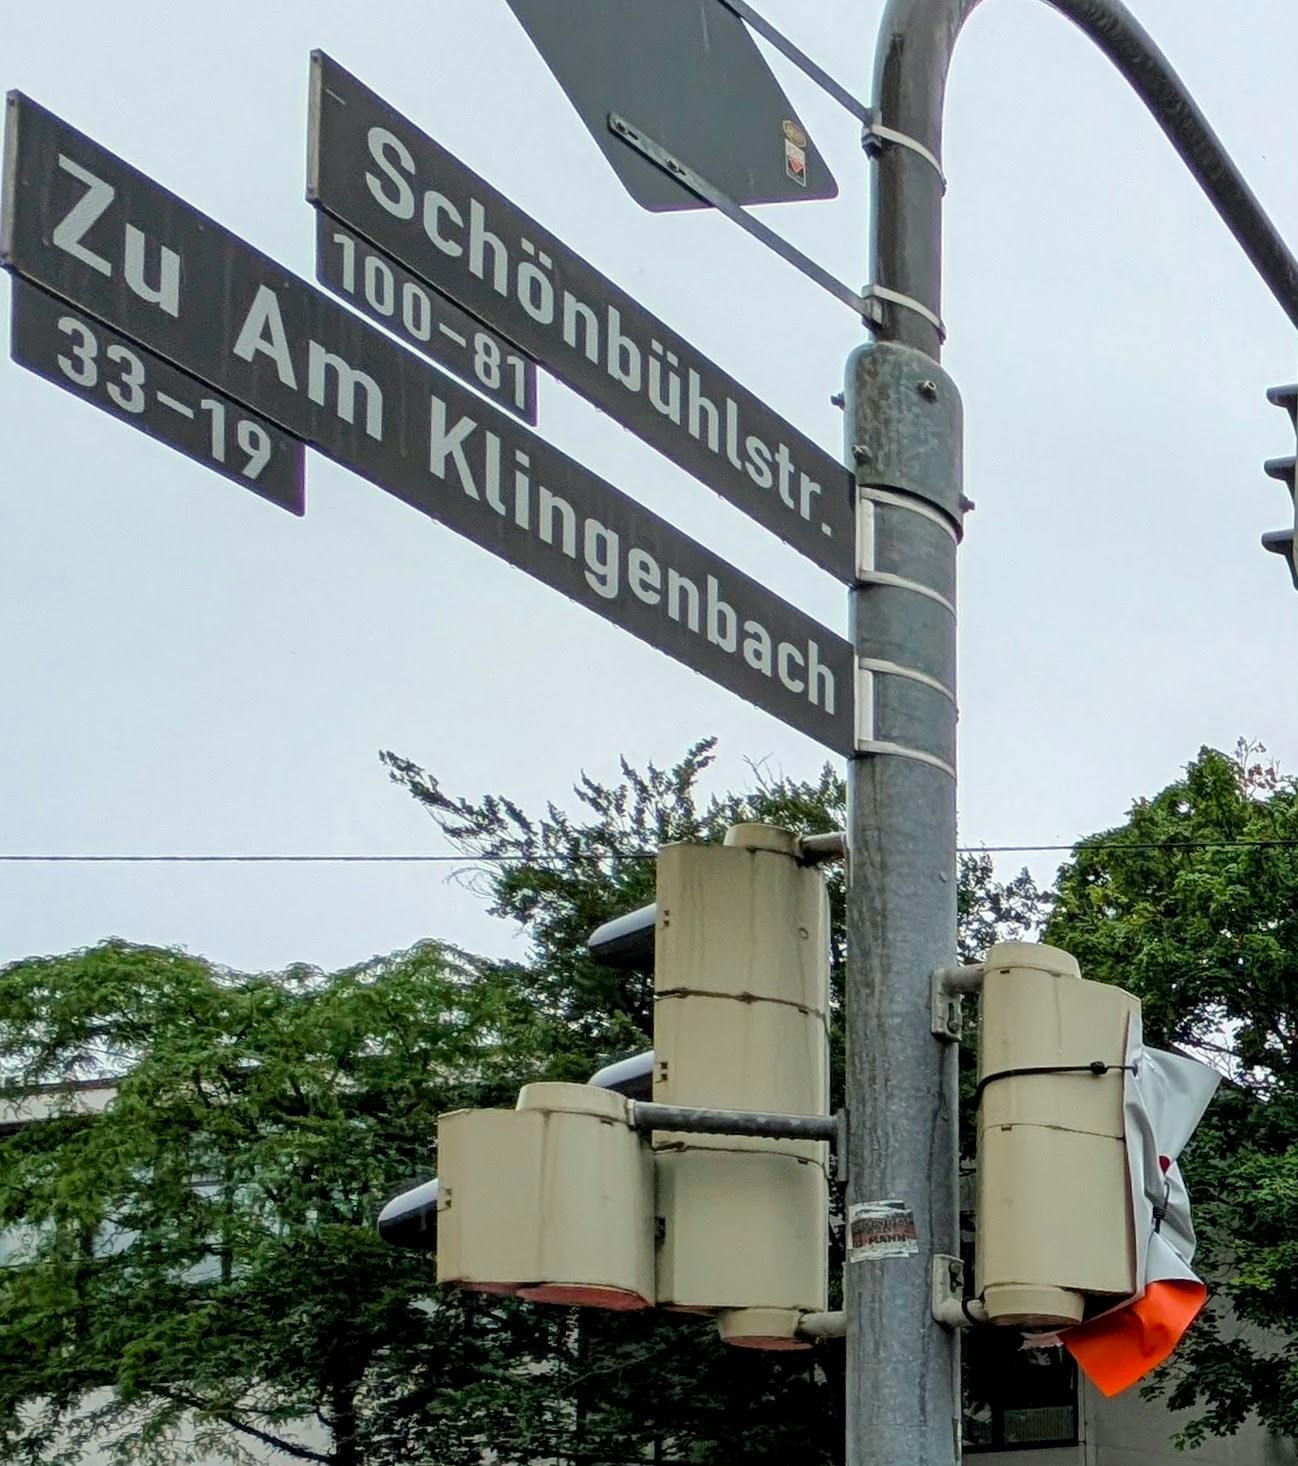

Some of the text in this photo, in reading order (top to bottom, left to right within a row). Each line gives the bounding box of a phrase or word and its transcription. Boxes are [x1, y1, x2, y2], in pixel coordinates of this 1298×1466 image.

[53, 153, 835, 715] Zu Am Klingenbach
[366, 126, 832, 538] Schönbühlstr.
